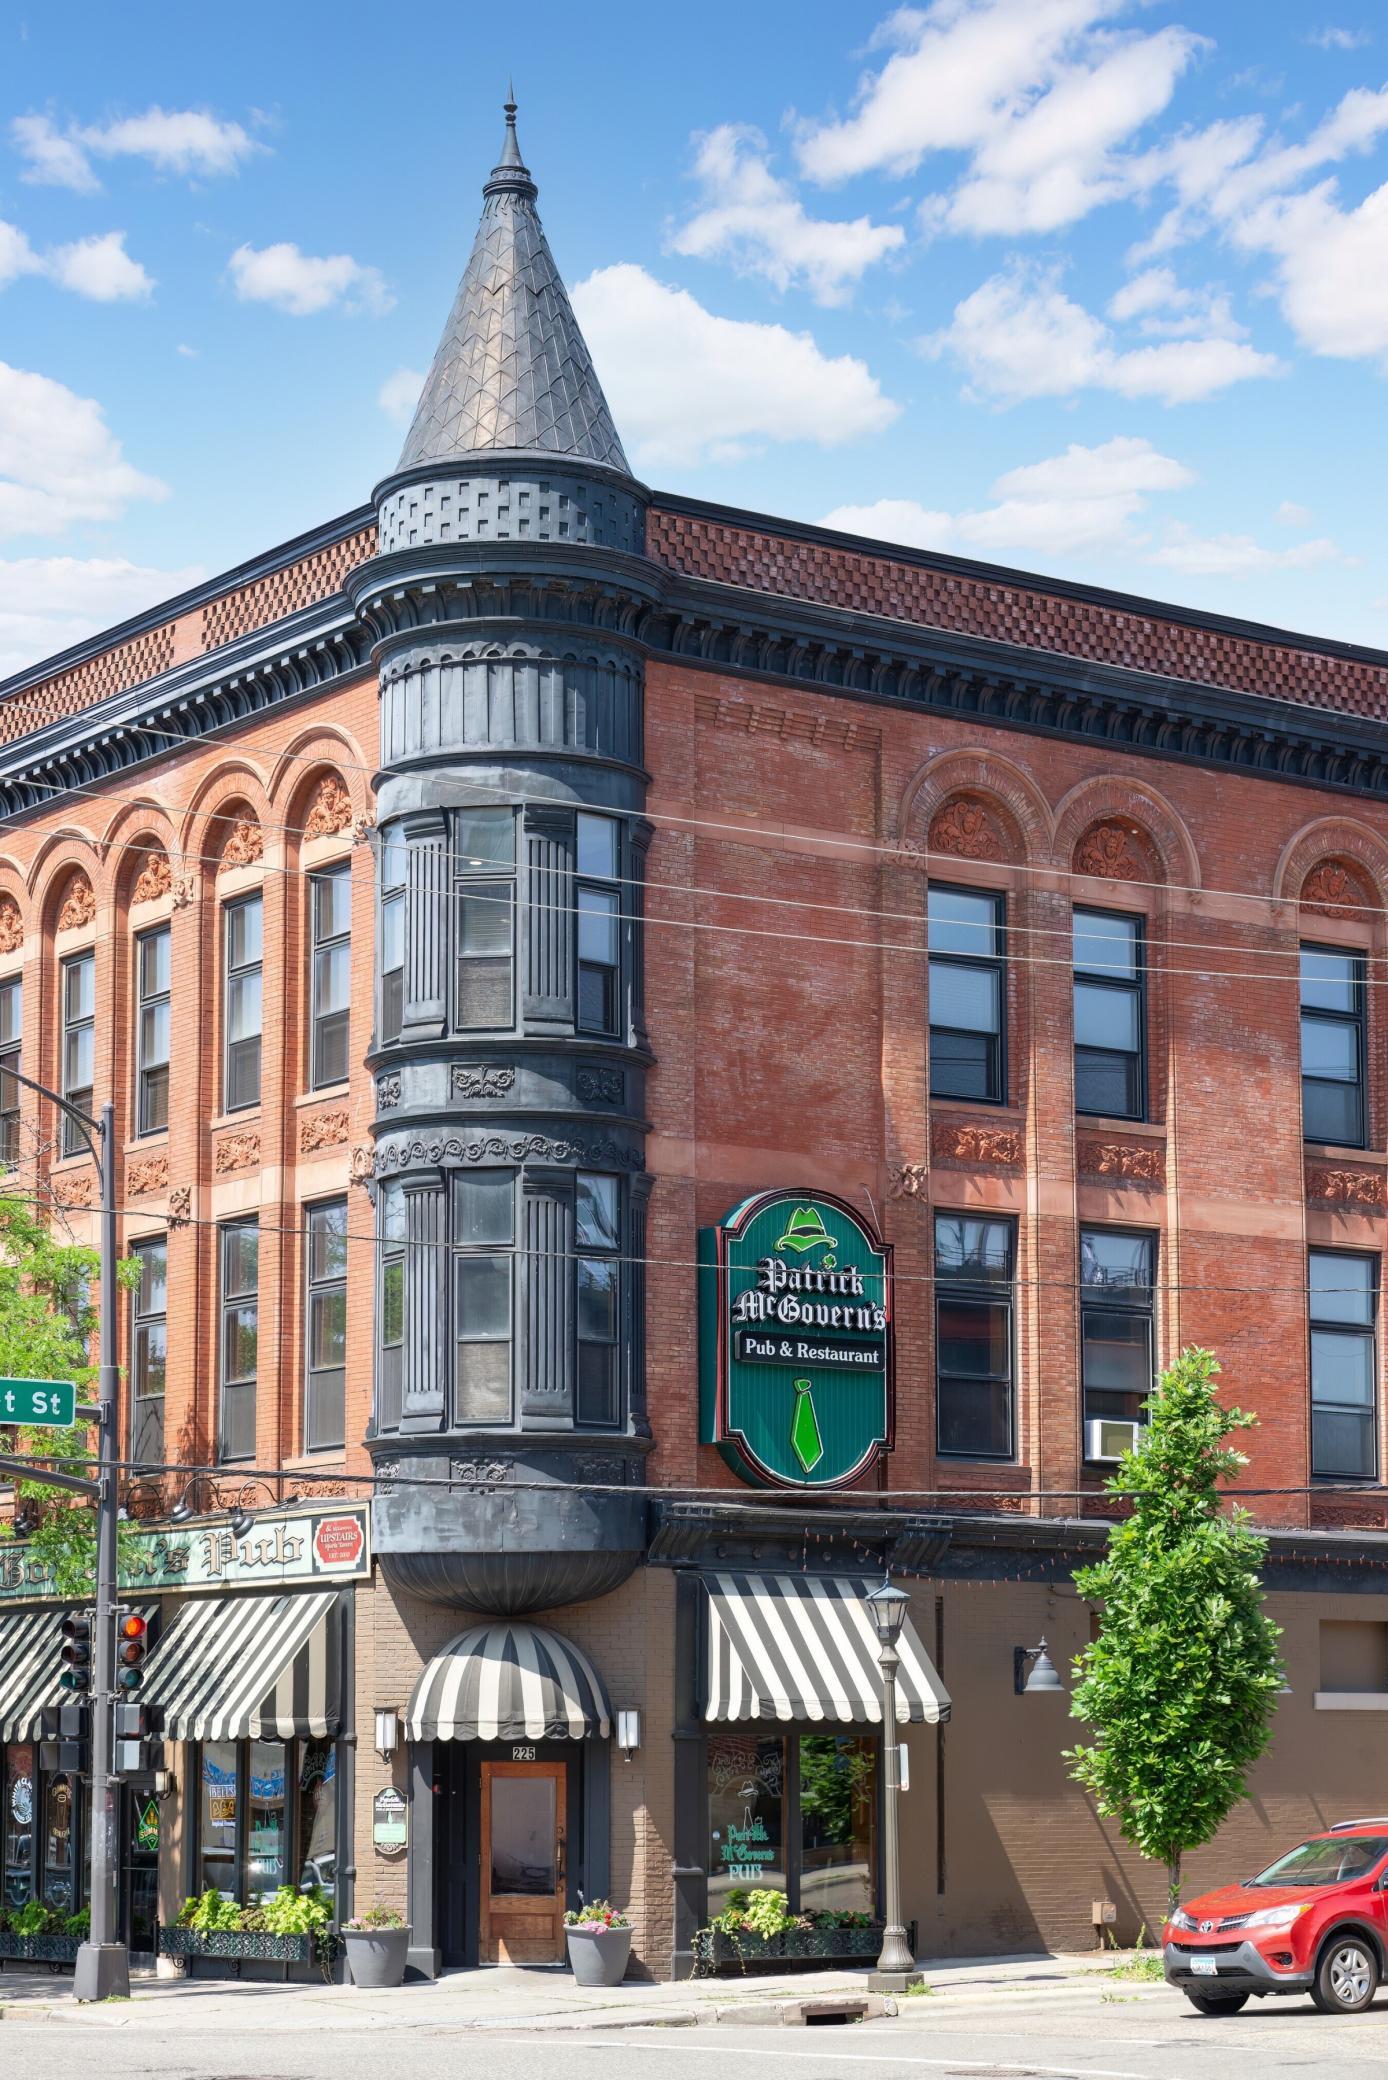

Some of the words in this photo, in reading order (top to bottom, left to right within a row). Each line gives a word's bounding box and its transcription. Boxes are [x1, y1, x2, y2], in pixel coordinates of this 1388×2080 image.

[759, 1257, 864, 1296] Patrick
[734, 1289, 887, 1331] McGovern's
[746, 1338, 776, 1356] Pub
[780, 1340, 793, 1357] &
[797, 1342, 879, 1364] Restaurant
[32, 1391, 60, 1415] St
[320, 1531, 358, 1543] UPSTAIRS
[200, 1526, 304, 1576] Pub
[514, 1748, 534, 1759] 225
[728, 1864, 763, 1880] PUB
